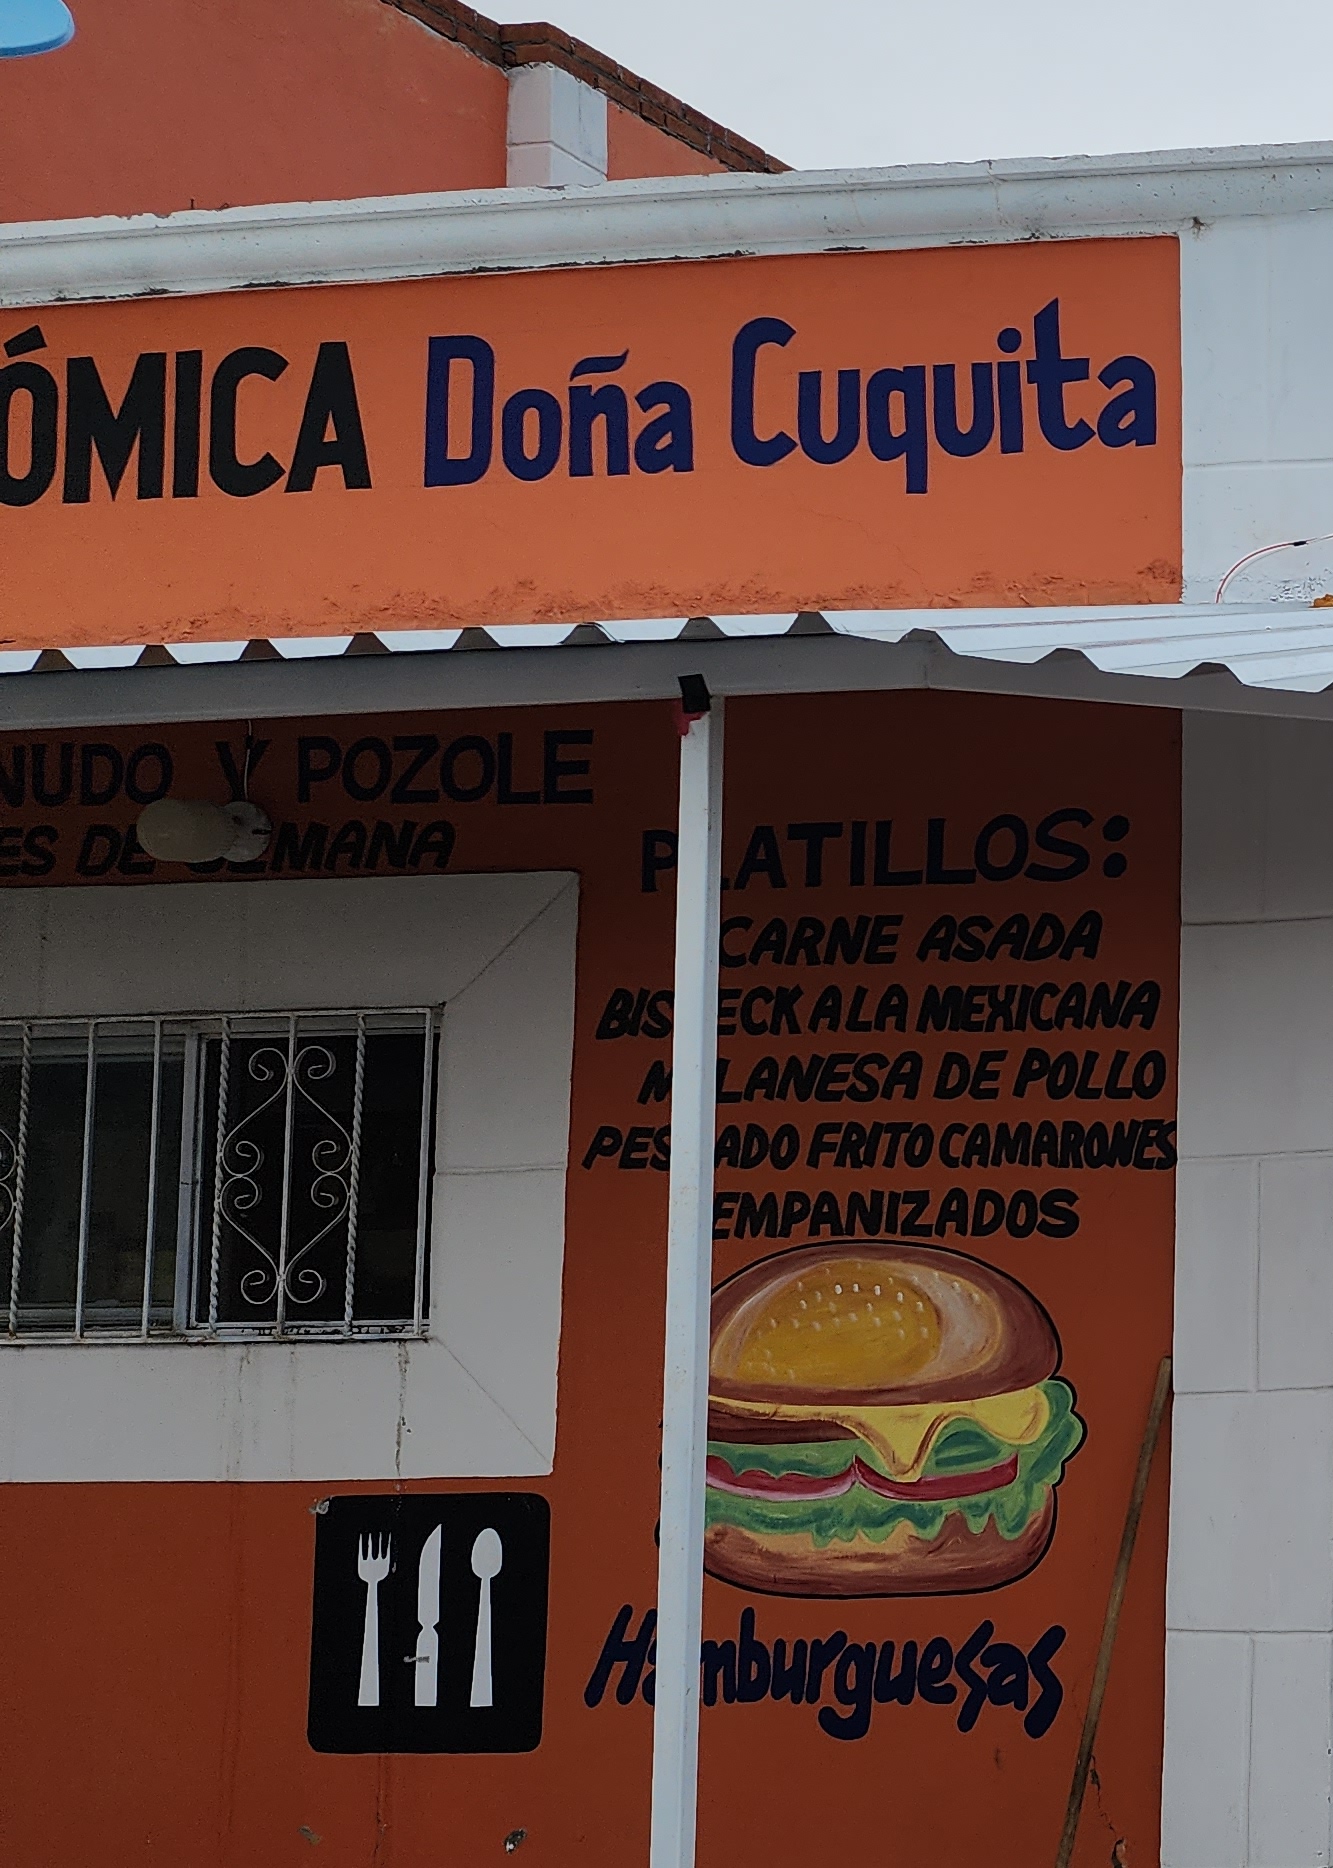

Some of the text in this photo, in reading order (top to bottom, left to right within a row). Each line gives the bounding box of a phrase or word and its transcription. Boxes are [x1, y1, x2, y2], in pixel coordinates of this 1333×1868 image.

[0, 297, 1156, 507] ÓMICA Doña Cuquita
[215, 739, 272, 802] Y
[298, 730, 594, 805] POZOLE
[187, 819, 456, 874] MANA
[641, 807, 1130, 893] PATILLOS:
[718, 909, 1104, 968] CARNE ASADA
[595, 983, 804, 1040] BISECK
[916, 979, 1162, 1034] MEXICANA
[636, 1047, 1167, 1105] MLANESA DE POLLO
[581, 1118, 1178, 1172] PESADO FRITO CAMARONES
[711, 1187, 1081, 1239] EMPANIZADOS
